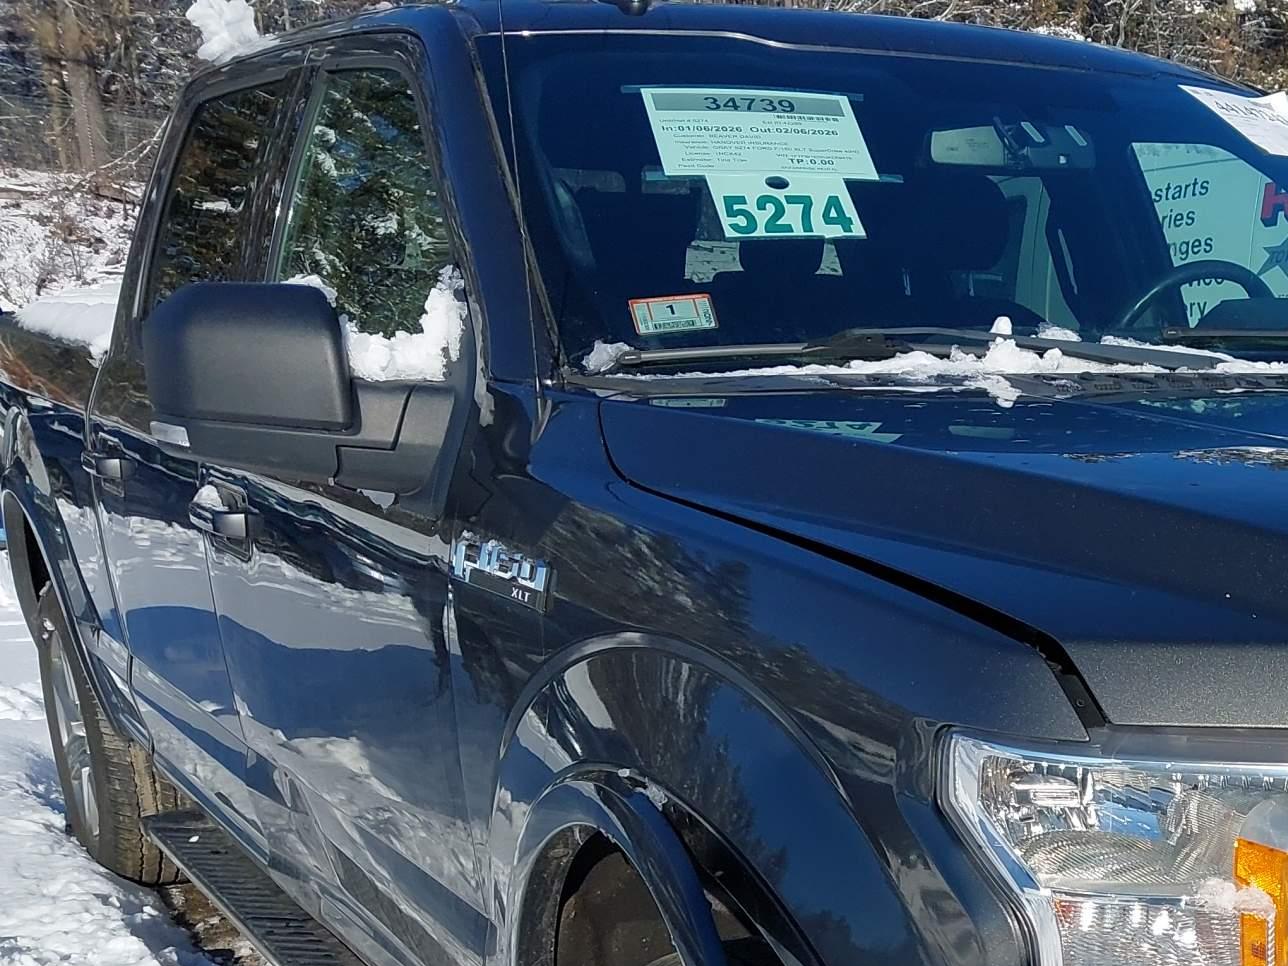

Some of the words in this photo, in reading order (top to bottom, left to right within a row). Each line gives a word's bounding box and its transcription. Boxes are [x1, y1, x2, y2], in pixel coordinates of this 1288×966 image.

[703, 96, 795, 113] 34739
[788, 158, 835, 166] TP:0.00
[722, 195, 854, 235] 5274
[665, 304, 676, 316] 1
[511, 586, 532, 602] XLT
